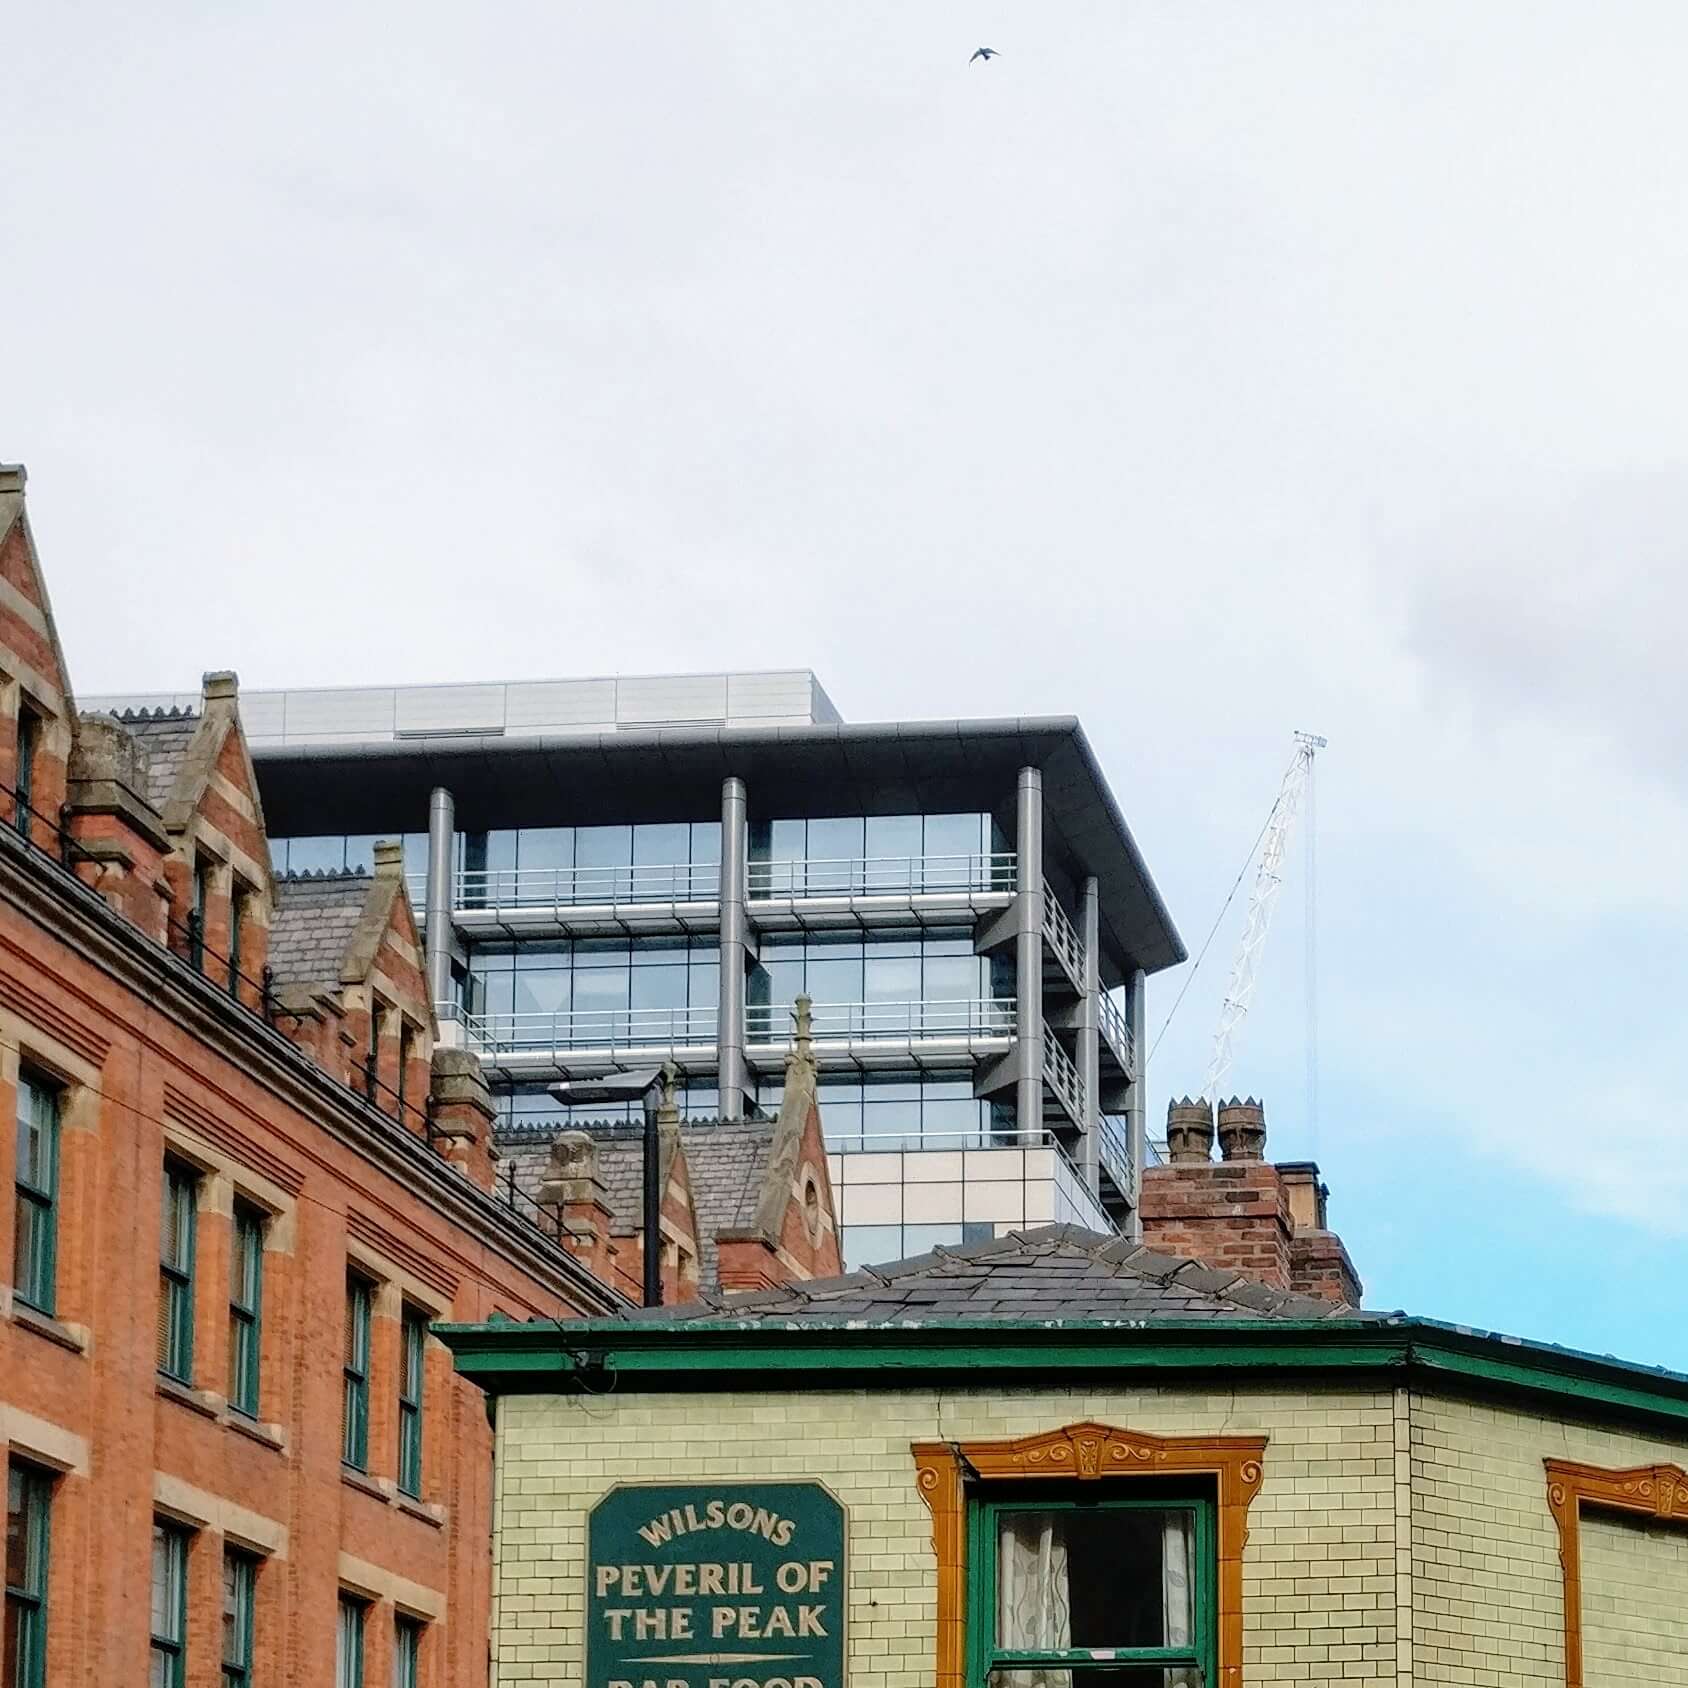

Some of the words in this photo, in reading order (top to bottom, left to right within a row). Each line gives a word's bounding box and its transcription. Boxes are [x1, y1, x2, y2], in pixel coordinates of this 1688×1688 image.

[638, 1502, 796, 1547] WILSONS
[596, 1563, 763, 1597] PEVERIL
[776, 1560, 834, 1594] OF
[603, 1607, 696, 1641] THE
[712, 1605, 829, 1640] PEAK
